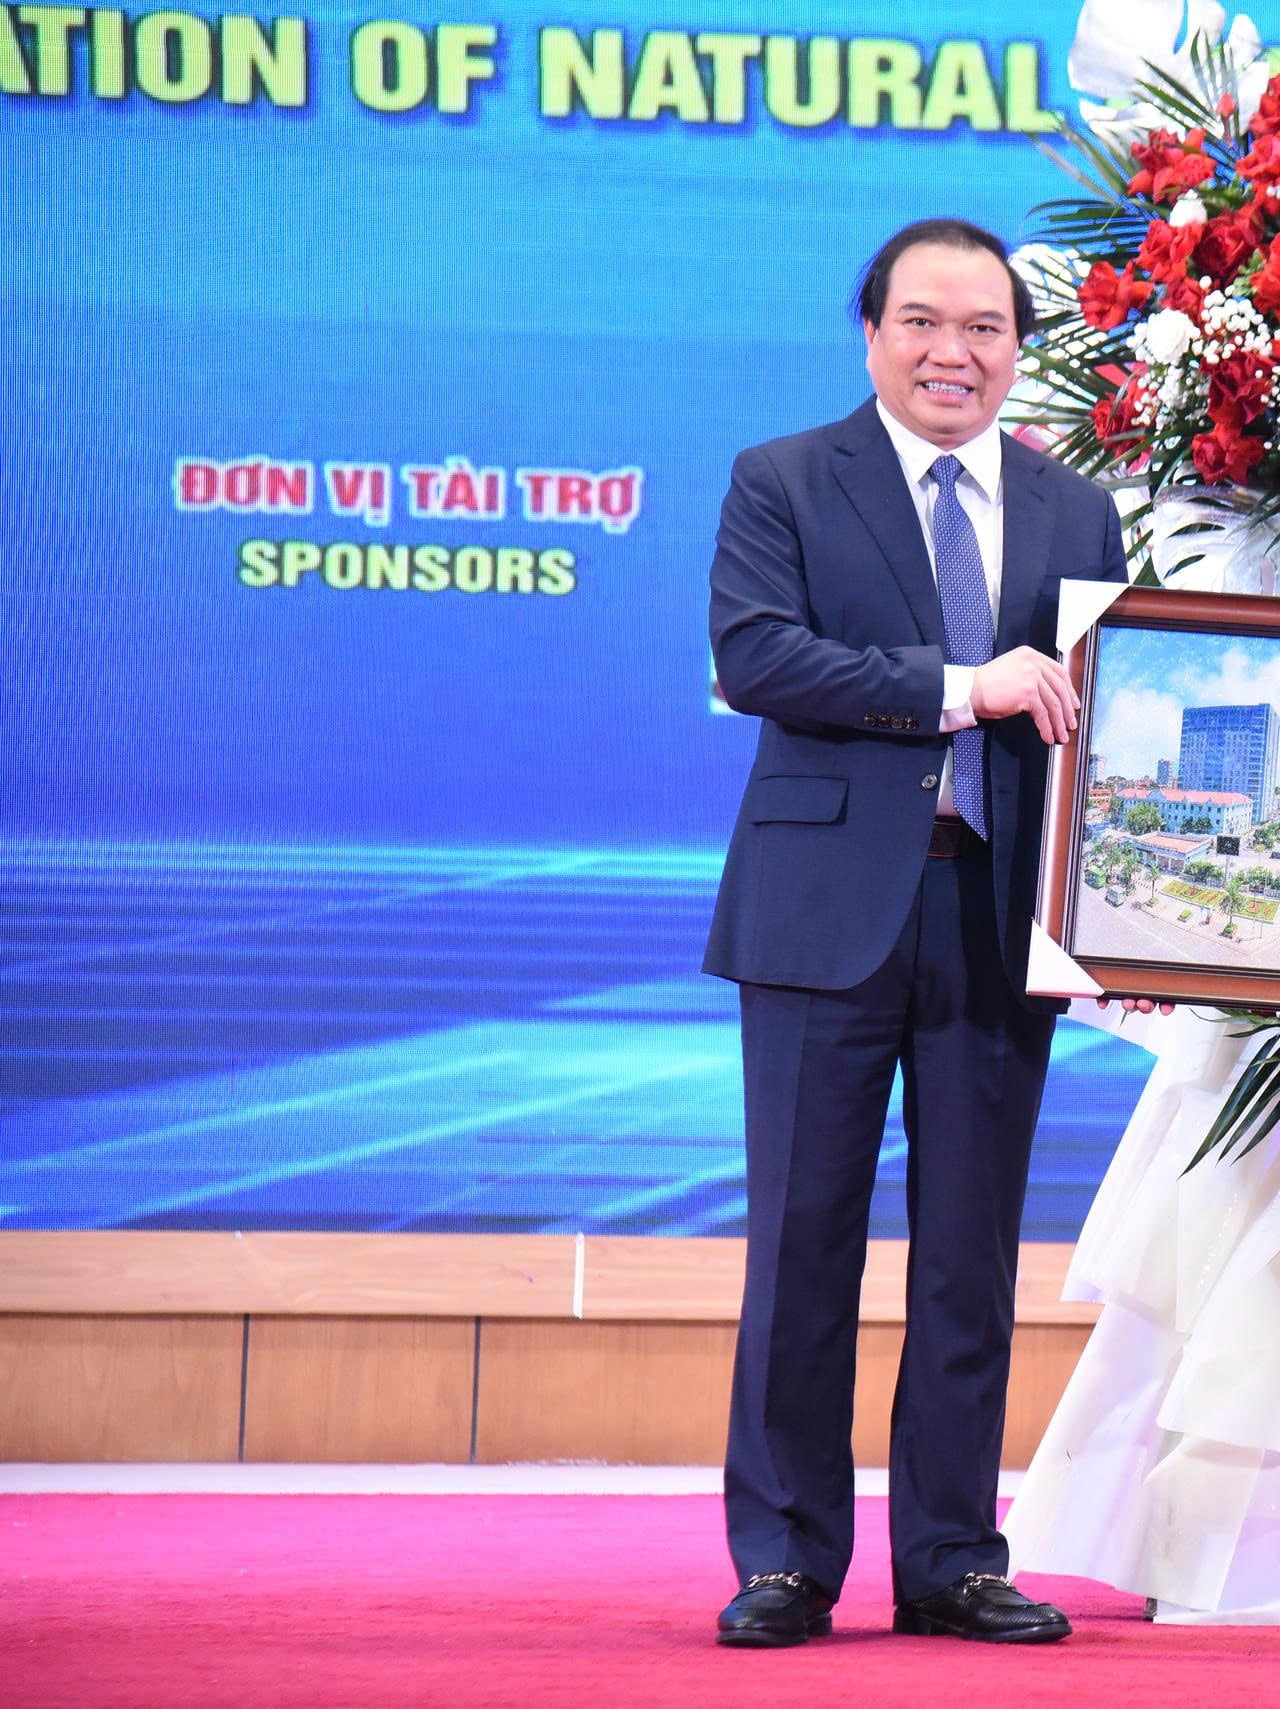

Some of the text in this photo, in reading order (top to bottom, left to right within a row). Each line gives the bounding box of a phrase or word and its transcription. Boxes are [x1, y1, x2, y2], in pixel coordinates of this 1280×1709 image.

[352, 19, 495, 112] OF
[540, 28, 1060, 133] NATURAL
[177, 460, 639, 528] ĐƠN VỊ TÀI TRỢ
[238, 539, 576, 595] SPONSORS
